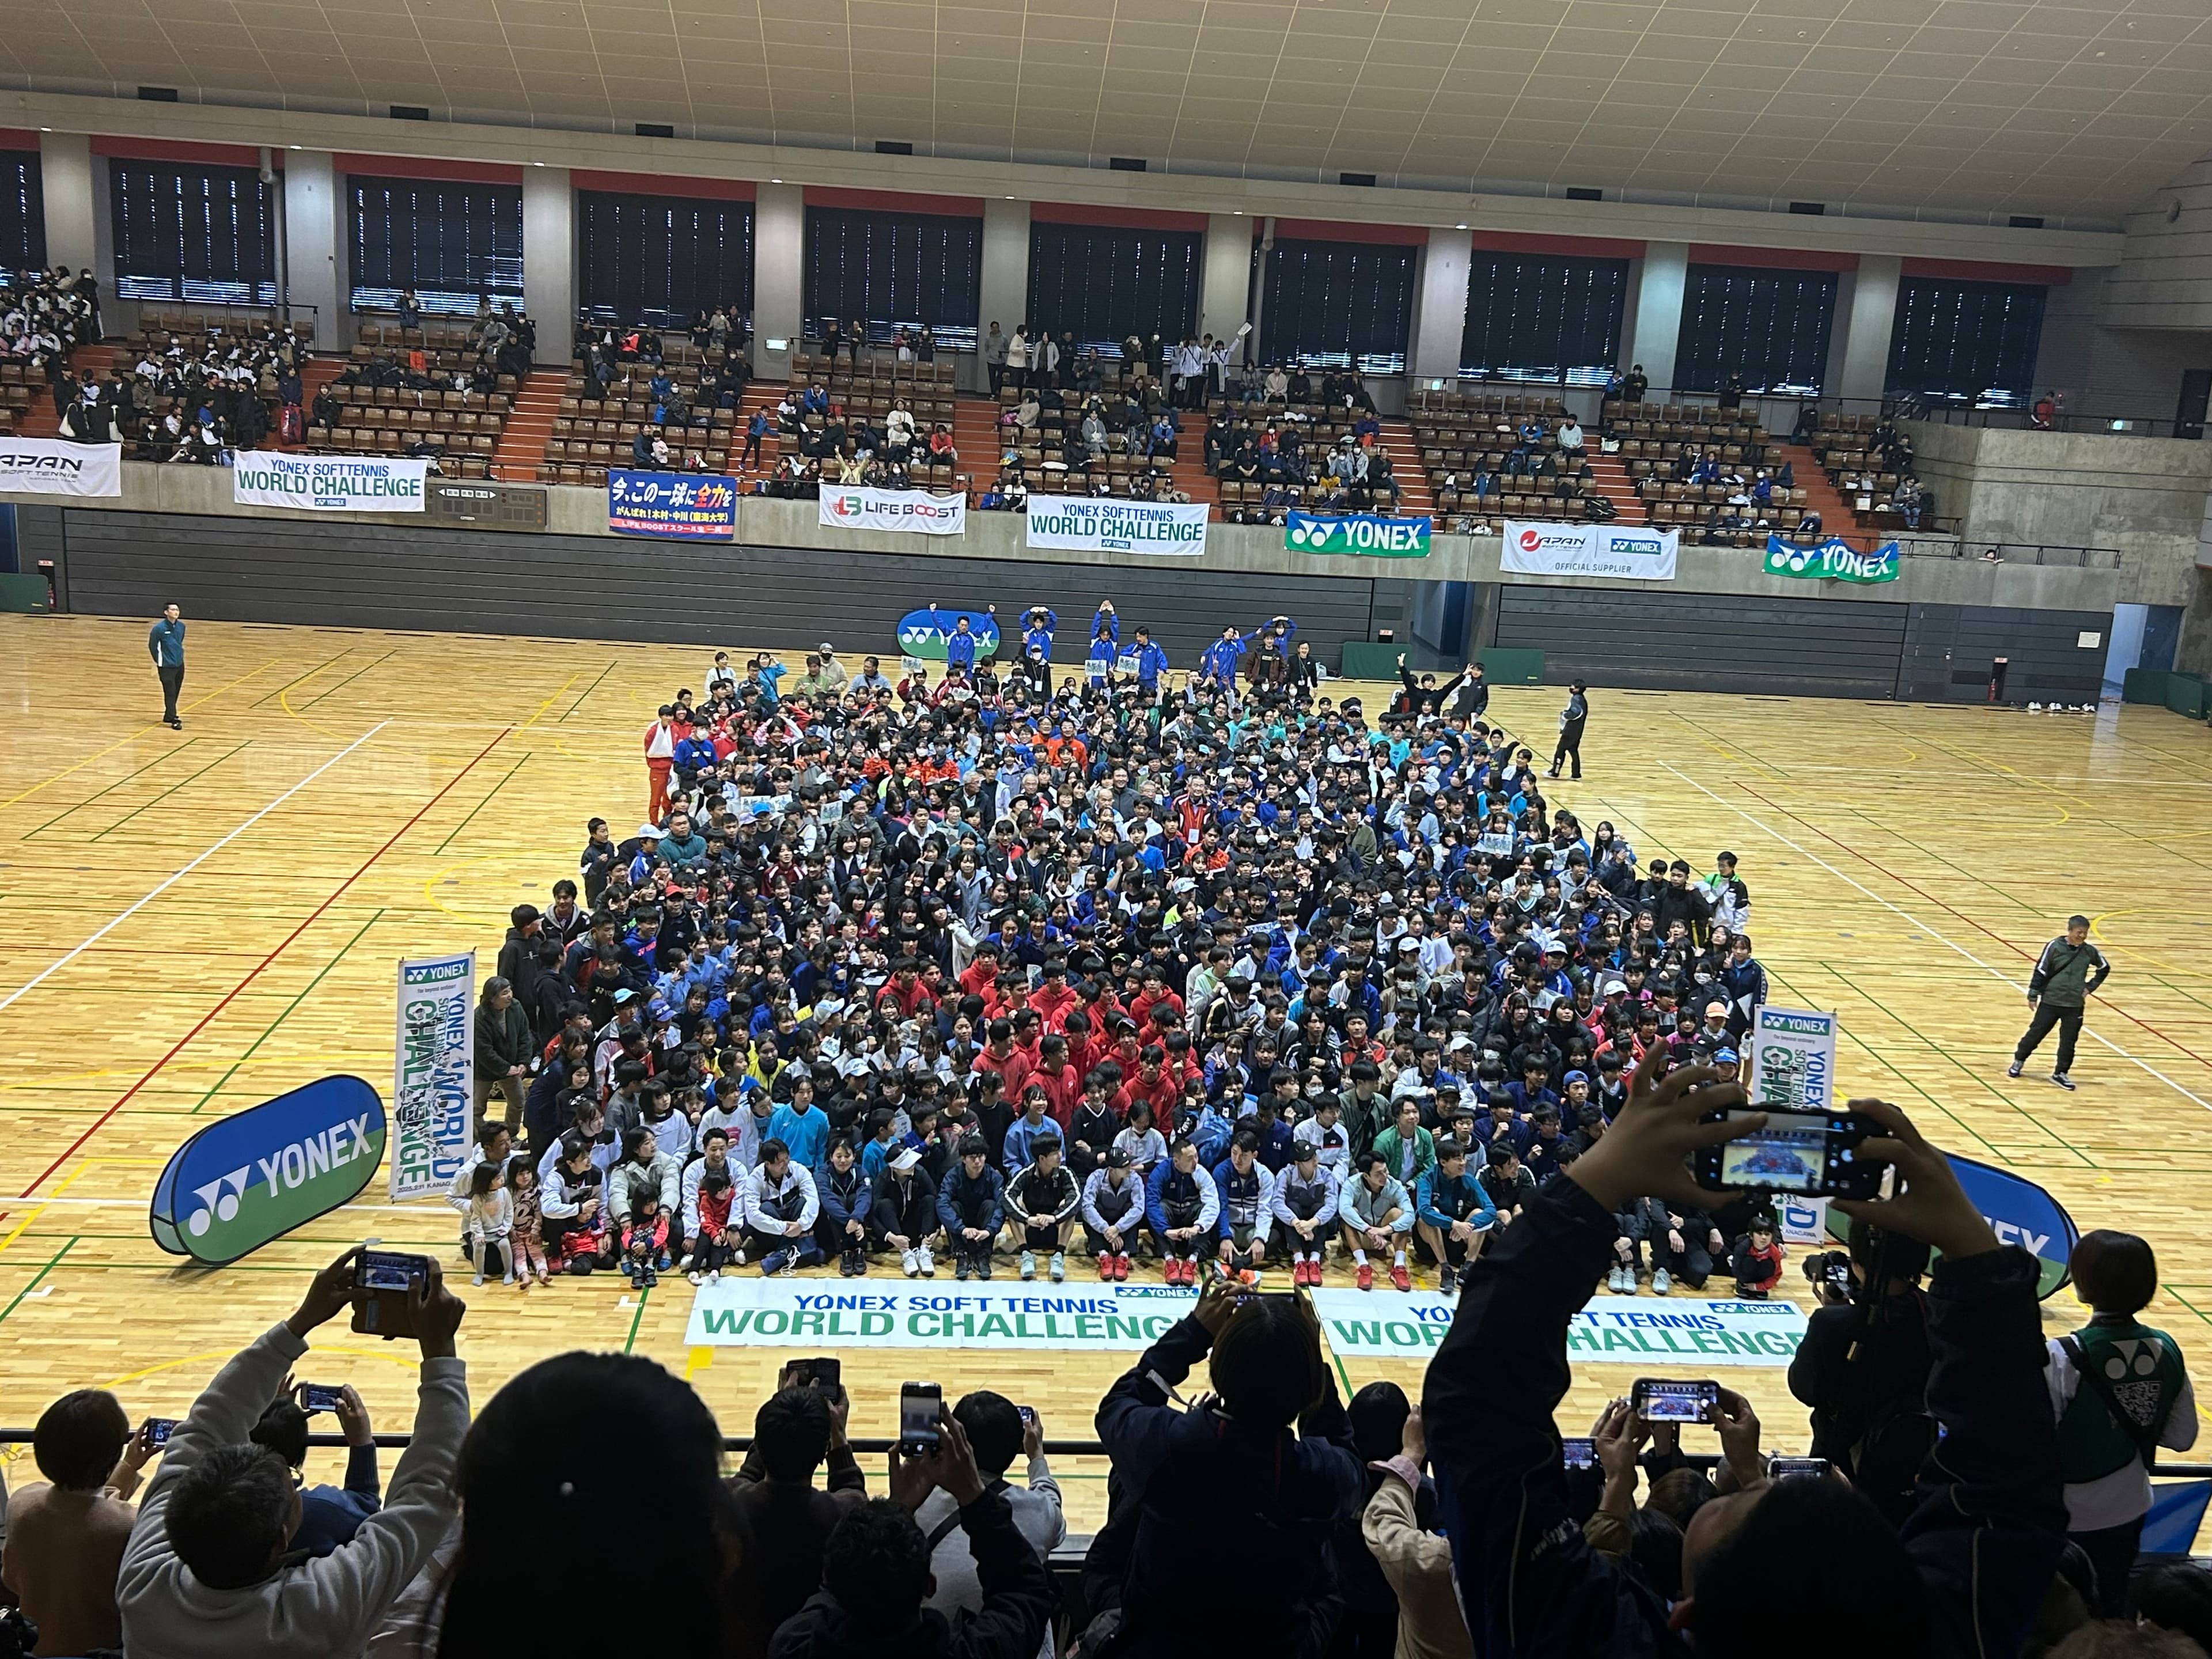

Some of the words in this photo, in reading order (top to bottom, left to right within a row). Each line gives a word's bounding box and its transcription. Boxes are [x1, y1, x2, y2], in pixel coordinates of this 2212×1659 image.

[271, 459, 310, 475] YONEX
[238, 469, 307, 494] WORLD
[312, 476, 421, 497] CHALLENGE
[612, 476, 733, 508] 今、この一球に全力を
[865, 501, 899, 514] LIFE
[903, 504, 959, 518] BOOST
[1063, 504, 1099, 517] YONEX
[641, 522, 669, 531] BOOST
[1031, 515, 1096, 536] WORLD
[1100, 518, 1203, 541] CHALLENGE
[1342, 520, 1423, 550] YONEX
[1112, 540, 1130, 548] YONEX
[1630, 540, 1660, 553] YONEX
[1555, 562, 1590, 571] OFFICIAL
[1592, 563, 1631, 573] SUPPLIER
[1820, 545, 1891, 578] YONEX
[430, 962, 465, 980] YONEX
[446, 991, 465, 1051] YONEX
[1787, 1018, 1826, 1034] YONEX
[1805, 1051, 1826, 1107] YONEX
[257, 1112, 373, 1198] YONEX
[1147, 1289, 1195, 1297] YONEX
[794, 1294, 899, 1310] YONEX
[908, 1296, 993, 1312] SOFT
[1001, 1297, 1119, 1313] TENNIS
[1740, 1304, 1789, 1313] YONEX
[703, 1309, 894, 1336] WORLD
[907, 1312, 1182, 1339] CHALLENG
[1606, 1312, 1725, 1330] TENNIS
[1331, 1320, 1451, 1346] WOR
[1566, 1327, 1805, 1355] HALLENG
